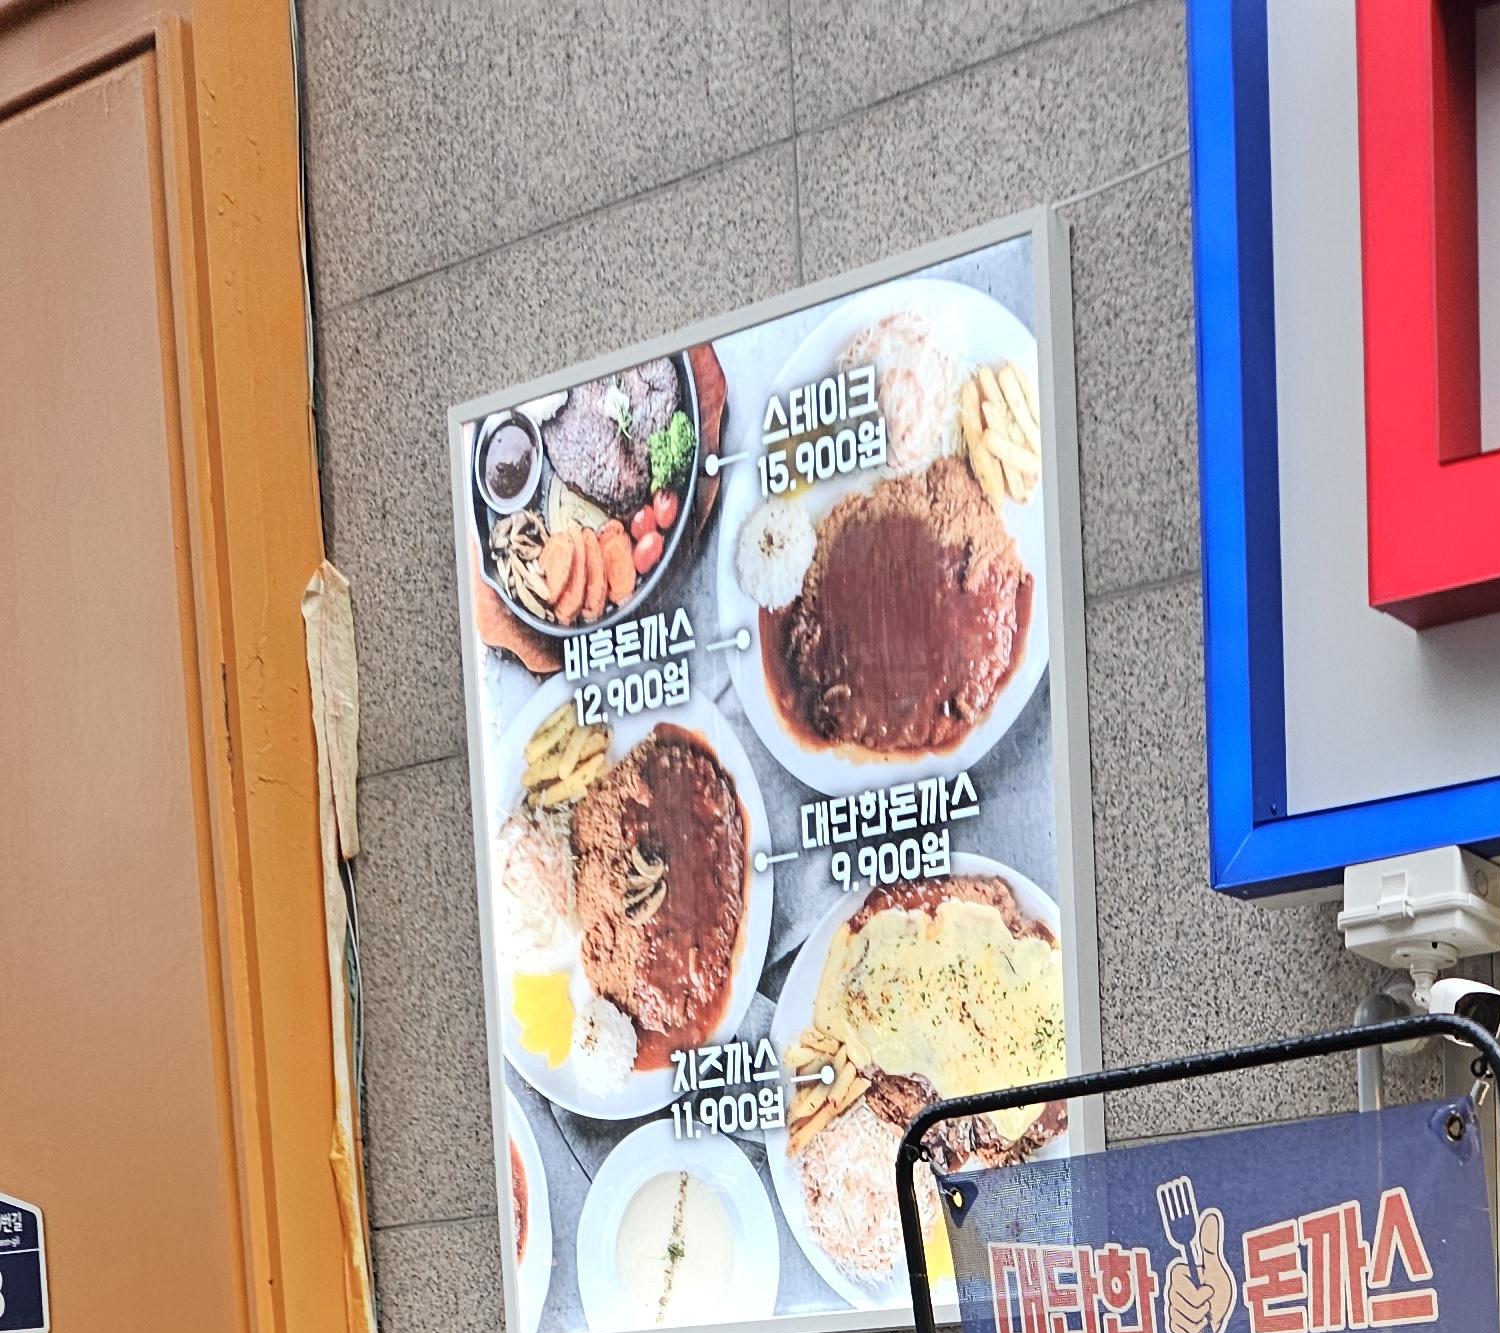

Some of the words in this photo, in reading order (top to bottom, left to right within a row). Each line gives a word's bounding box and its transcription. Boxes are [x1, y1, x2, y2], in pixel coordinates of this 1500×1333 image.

[761, 364, 879, 444] 스테이크
[756, 421, 888, 495] 15.900원
[562, 607, 696, 680] 비후돈까스
[571, 665, 692, 725] 12.900원
[800, 772, 981, 850] 대단한돈까스
[830, 830, 952, 891] 9.900원
[671, 1039, 781, 1094] 치즈까스
[669, 1087, 786, 1140] 11.900원
